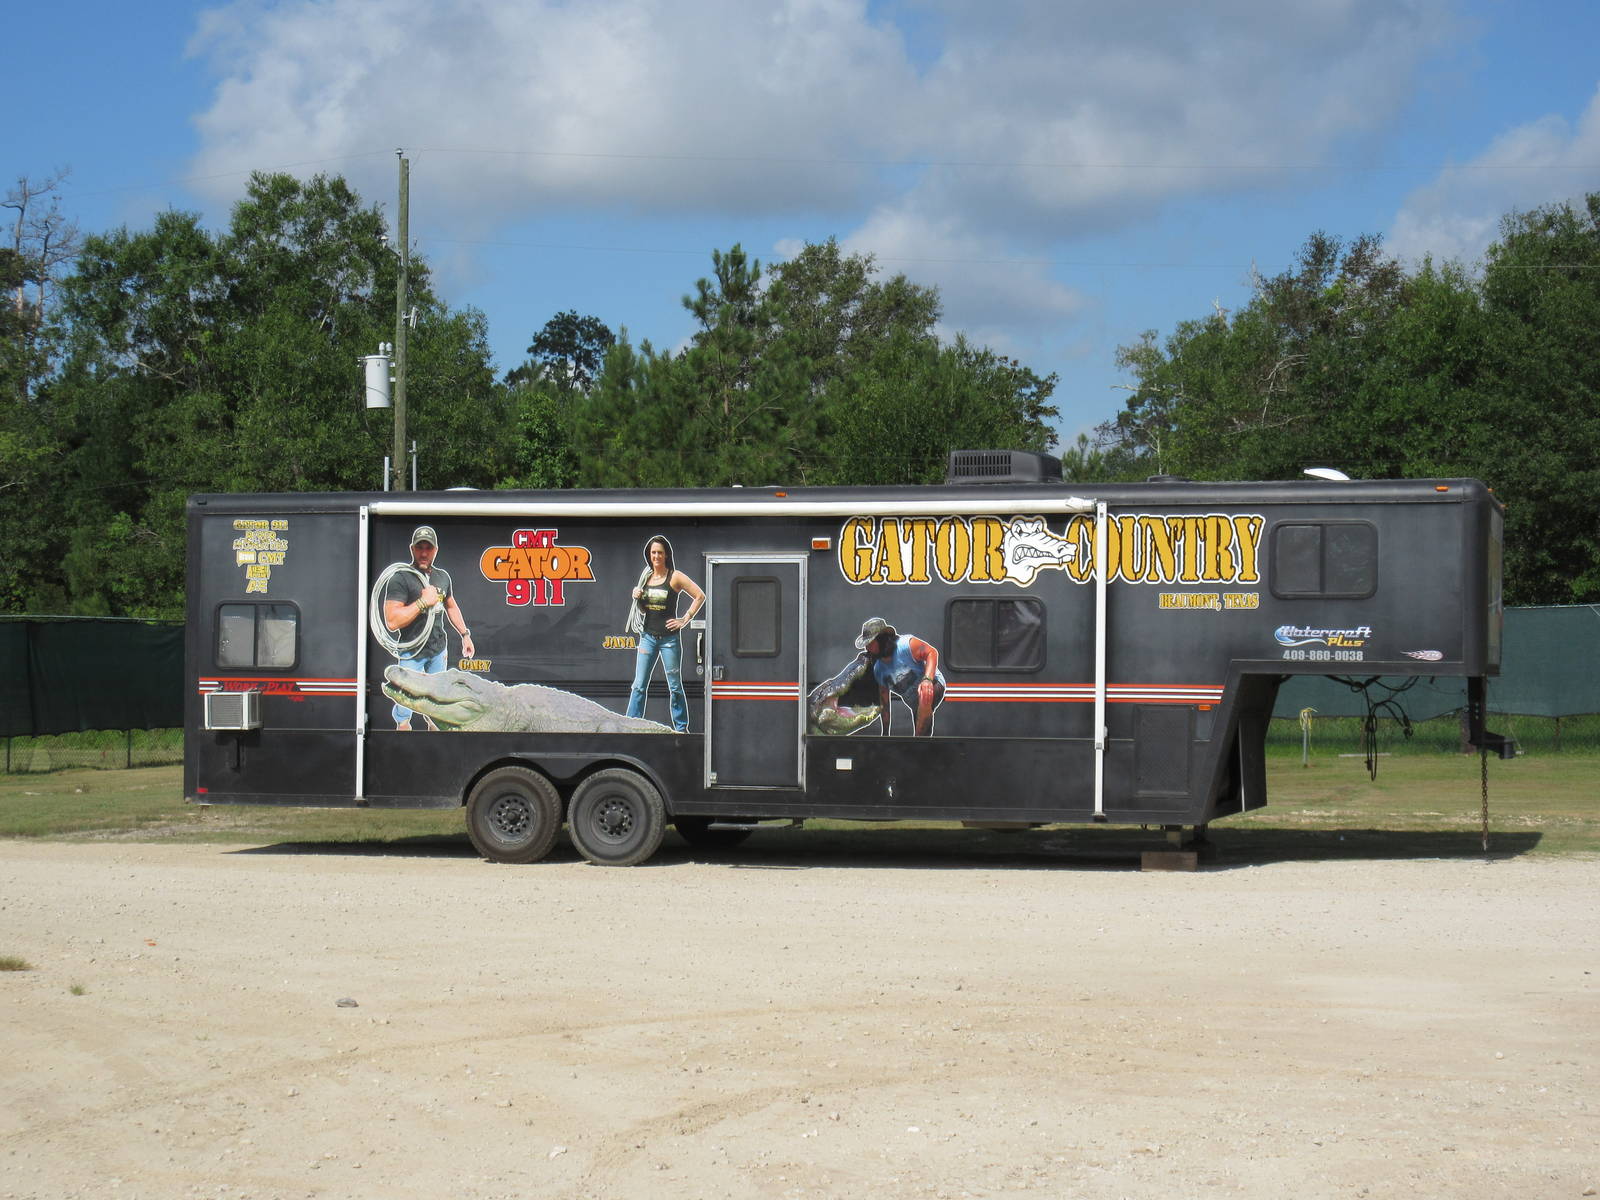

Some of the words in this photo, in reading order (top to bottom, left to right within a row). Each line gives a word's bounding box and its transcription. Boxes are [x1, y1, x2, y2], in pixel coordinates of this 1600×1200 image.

[513, 530, 557, 548] CMT
[840, 516, 1006, 583] GATOR
[1066, 515, 1263, 583] COUNTRY
[258, 552, 285, 564] CMT
[480, 547, 594, 580] GATOR
[506, 579, 565, 605] 911
[1159, 593, 1222, 611] BEAUMONT,
[1223, 593, 1259, 609] TEXAS
[1279, 626, 1372, 637] Watercraft
[602, 637, 636, 648] JANA
[1327, 635, 1364, 646] Plus
[459, 659, 491, 671] GARY
